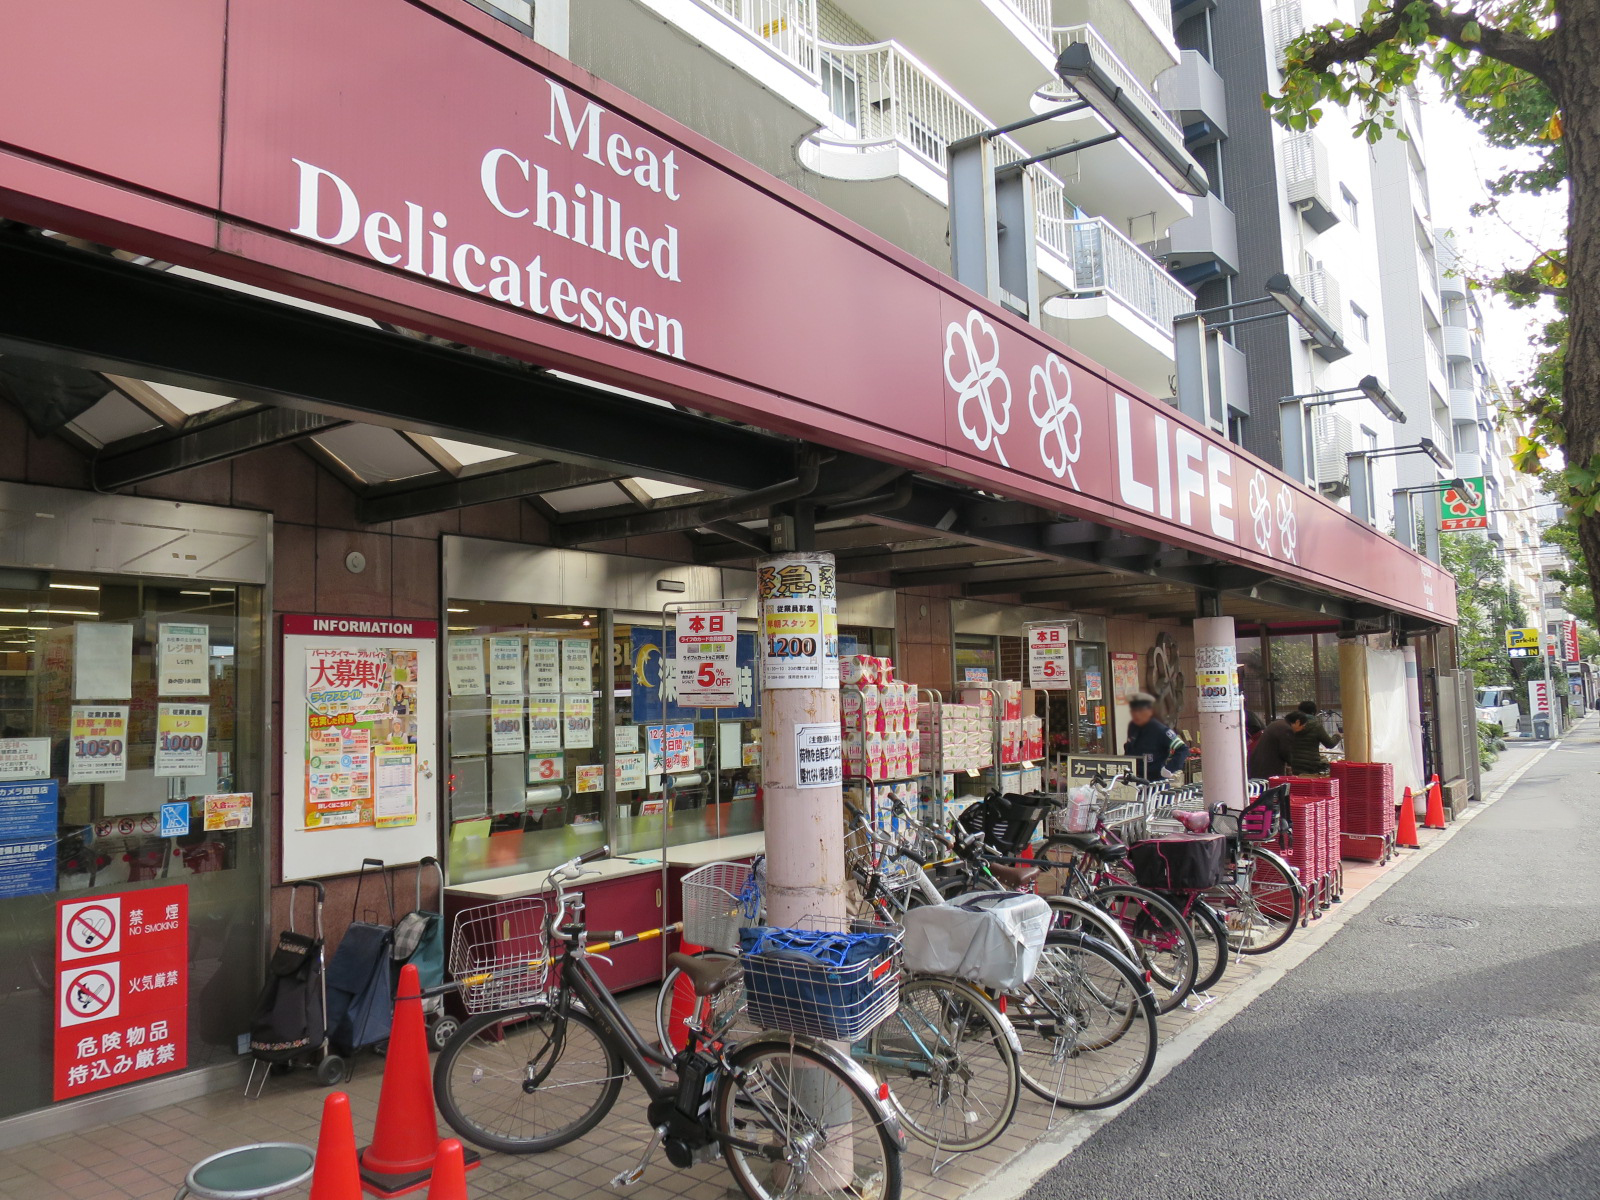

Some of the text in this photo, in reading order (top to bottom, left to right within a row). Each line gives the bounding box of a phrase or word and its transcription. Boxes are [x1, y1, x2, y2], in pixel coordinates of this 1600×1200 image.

[544, 78, 681, 201] Meat
[481, 148, 682, 283] Chilled
[290, 157, 686, 361] Delicatessen
[1115, 393, 1235, 541] LIFE
[1446, 519, 1482, 529] ライフ
[777, 605, 814, 613] 従業員募集
[313, 619, 413, 635] INFORMATION
[689, 615, 724, 633] 本日
[767, 619, 817, 629] 早朝スタッフ
[1037, 631, 1059, 642] 本日
[1508, 630, 1539, 646] Park-it!
[1563, 621, 1575, 661] makita
[168, 644, 203, 654] レジ部門
[312, 649, 388, 659] パートタイマー・アルバイト
[767, 637, 817, 658] 1200
[1528, 648, 1539, 656] IN
[697, 662, 716, 687] 5
[1044, 661, 1055, 677] 5
[716, 678, 731, 687] OFF
[311, 689, 363, 703] ライフスタイル
[1200, 686, 1227, 697] 1050
[1536, 683, 1550, 714] KIRI
[77, 719, 122, 728] 野菜・果物
[310, 713, 355, 726] 充実した待遇
[494, 719, 520, 732] 1050
[91, 728, 107, 736] 部門
[75, 739, 123, 757] 1050
[160, 735, 203, 752] 1000
[1074, 763, 1131, 776] カート置場
[0, 786, 49, 796] カメラ設置店
[211, 801, 227, 809] 入会
[129, 904, 179, 926] 禁煙
[129, 921, 179, 936] NO SMOKING
[128, 970, 179, 994] 火気厳禁
[76, 1020, 169, 1060] 危険物品
[68, 1043, 176, 1087] 持込み厳禁
